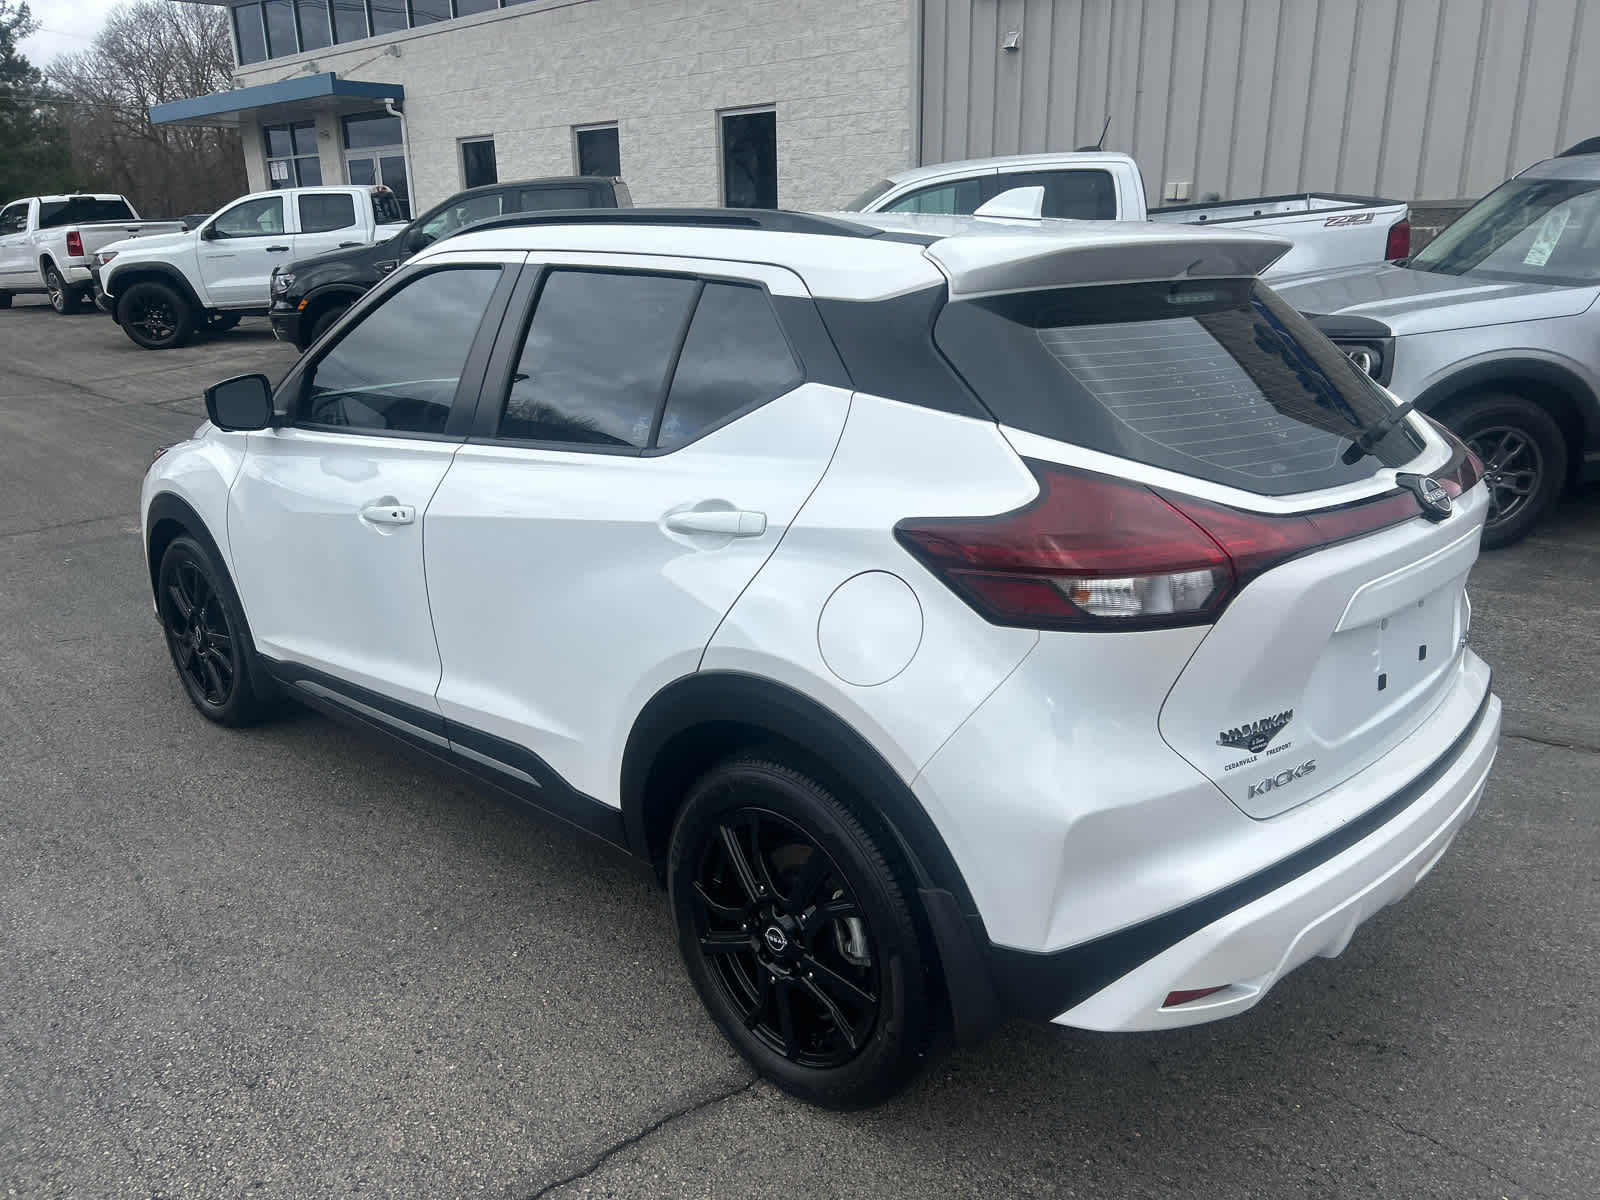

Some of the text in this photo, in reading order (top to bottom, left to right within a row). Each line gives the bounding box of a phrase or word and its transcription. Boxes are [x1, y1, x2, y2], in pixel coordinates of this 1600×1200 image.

[1224, 755, 1258, 772] CEDARVILLE
[1266, 742, 1292, 756] FREEPORT
[1248, 759, 1316, 800] KICKS
